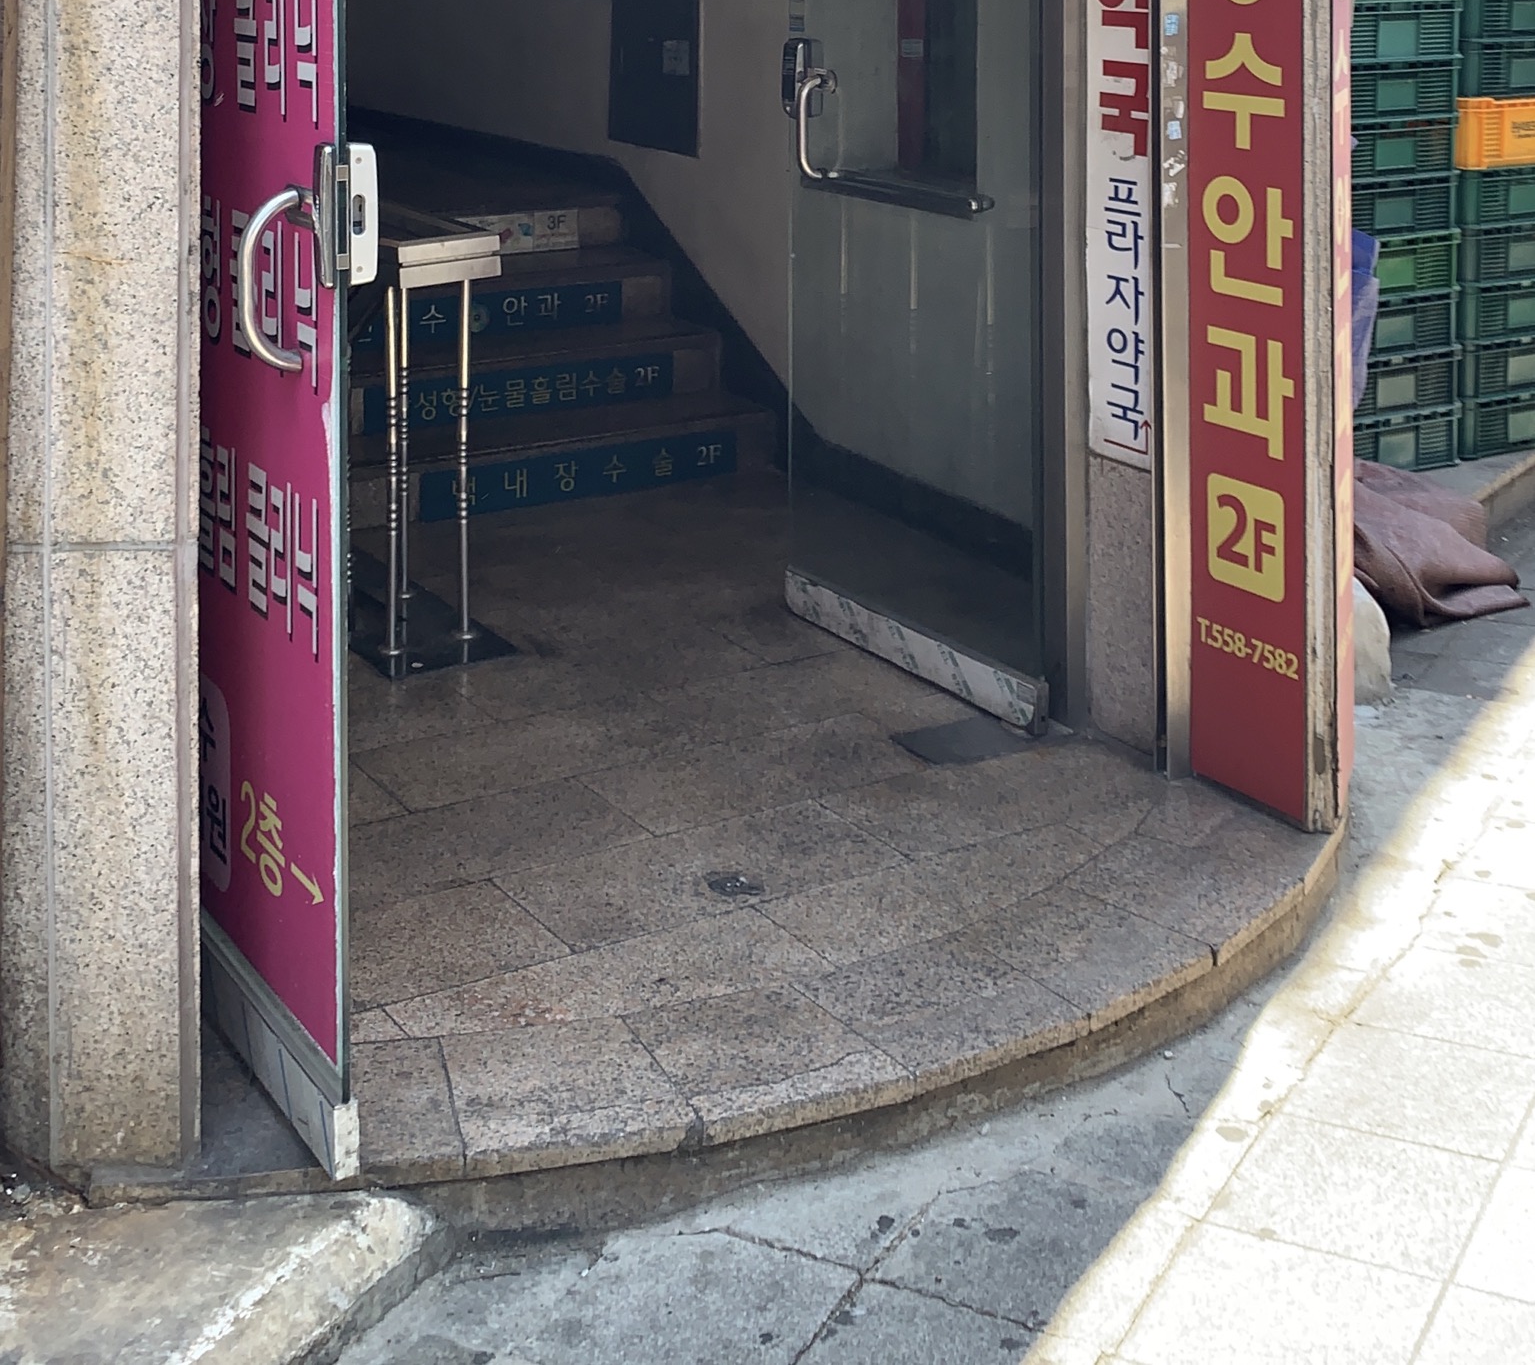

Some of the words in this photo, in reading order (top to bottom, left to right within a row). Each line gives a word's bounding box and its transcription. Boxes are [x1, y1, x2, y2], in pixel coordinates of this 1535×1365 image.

[546, 214, 567, 231] 3F
[1103, 177, 1146, 442] 프라자약국
[407, 365, 627, 422] 성형/눈물흘림수술
[634, 365, 660, 386] 2F
[696, 446, 723, 467] 2F
[246, 462, 318, 660] 클리닉
[1215, 492, 1277, 573] 2F
[1196, 616, 1299, 681] T.558-7582
[239, 779, 286, 897] 2층
